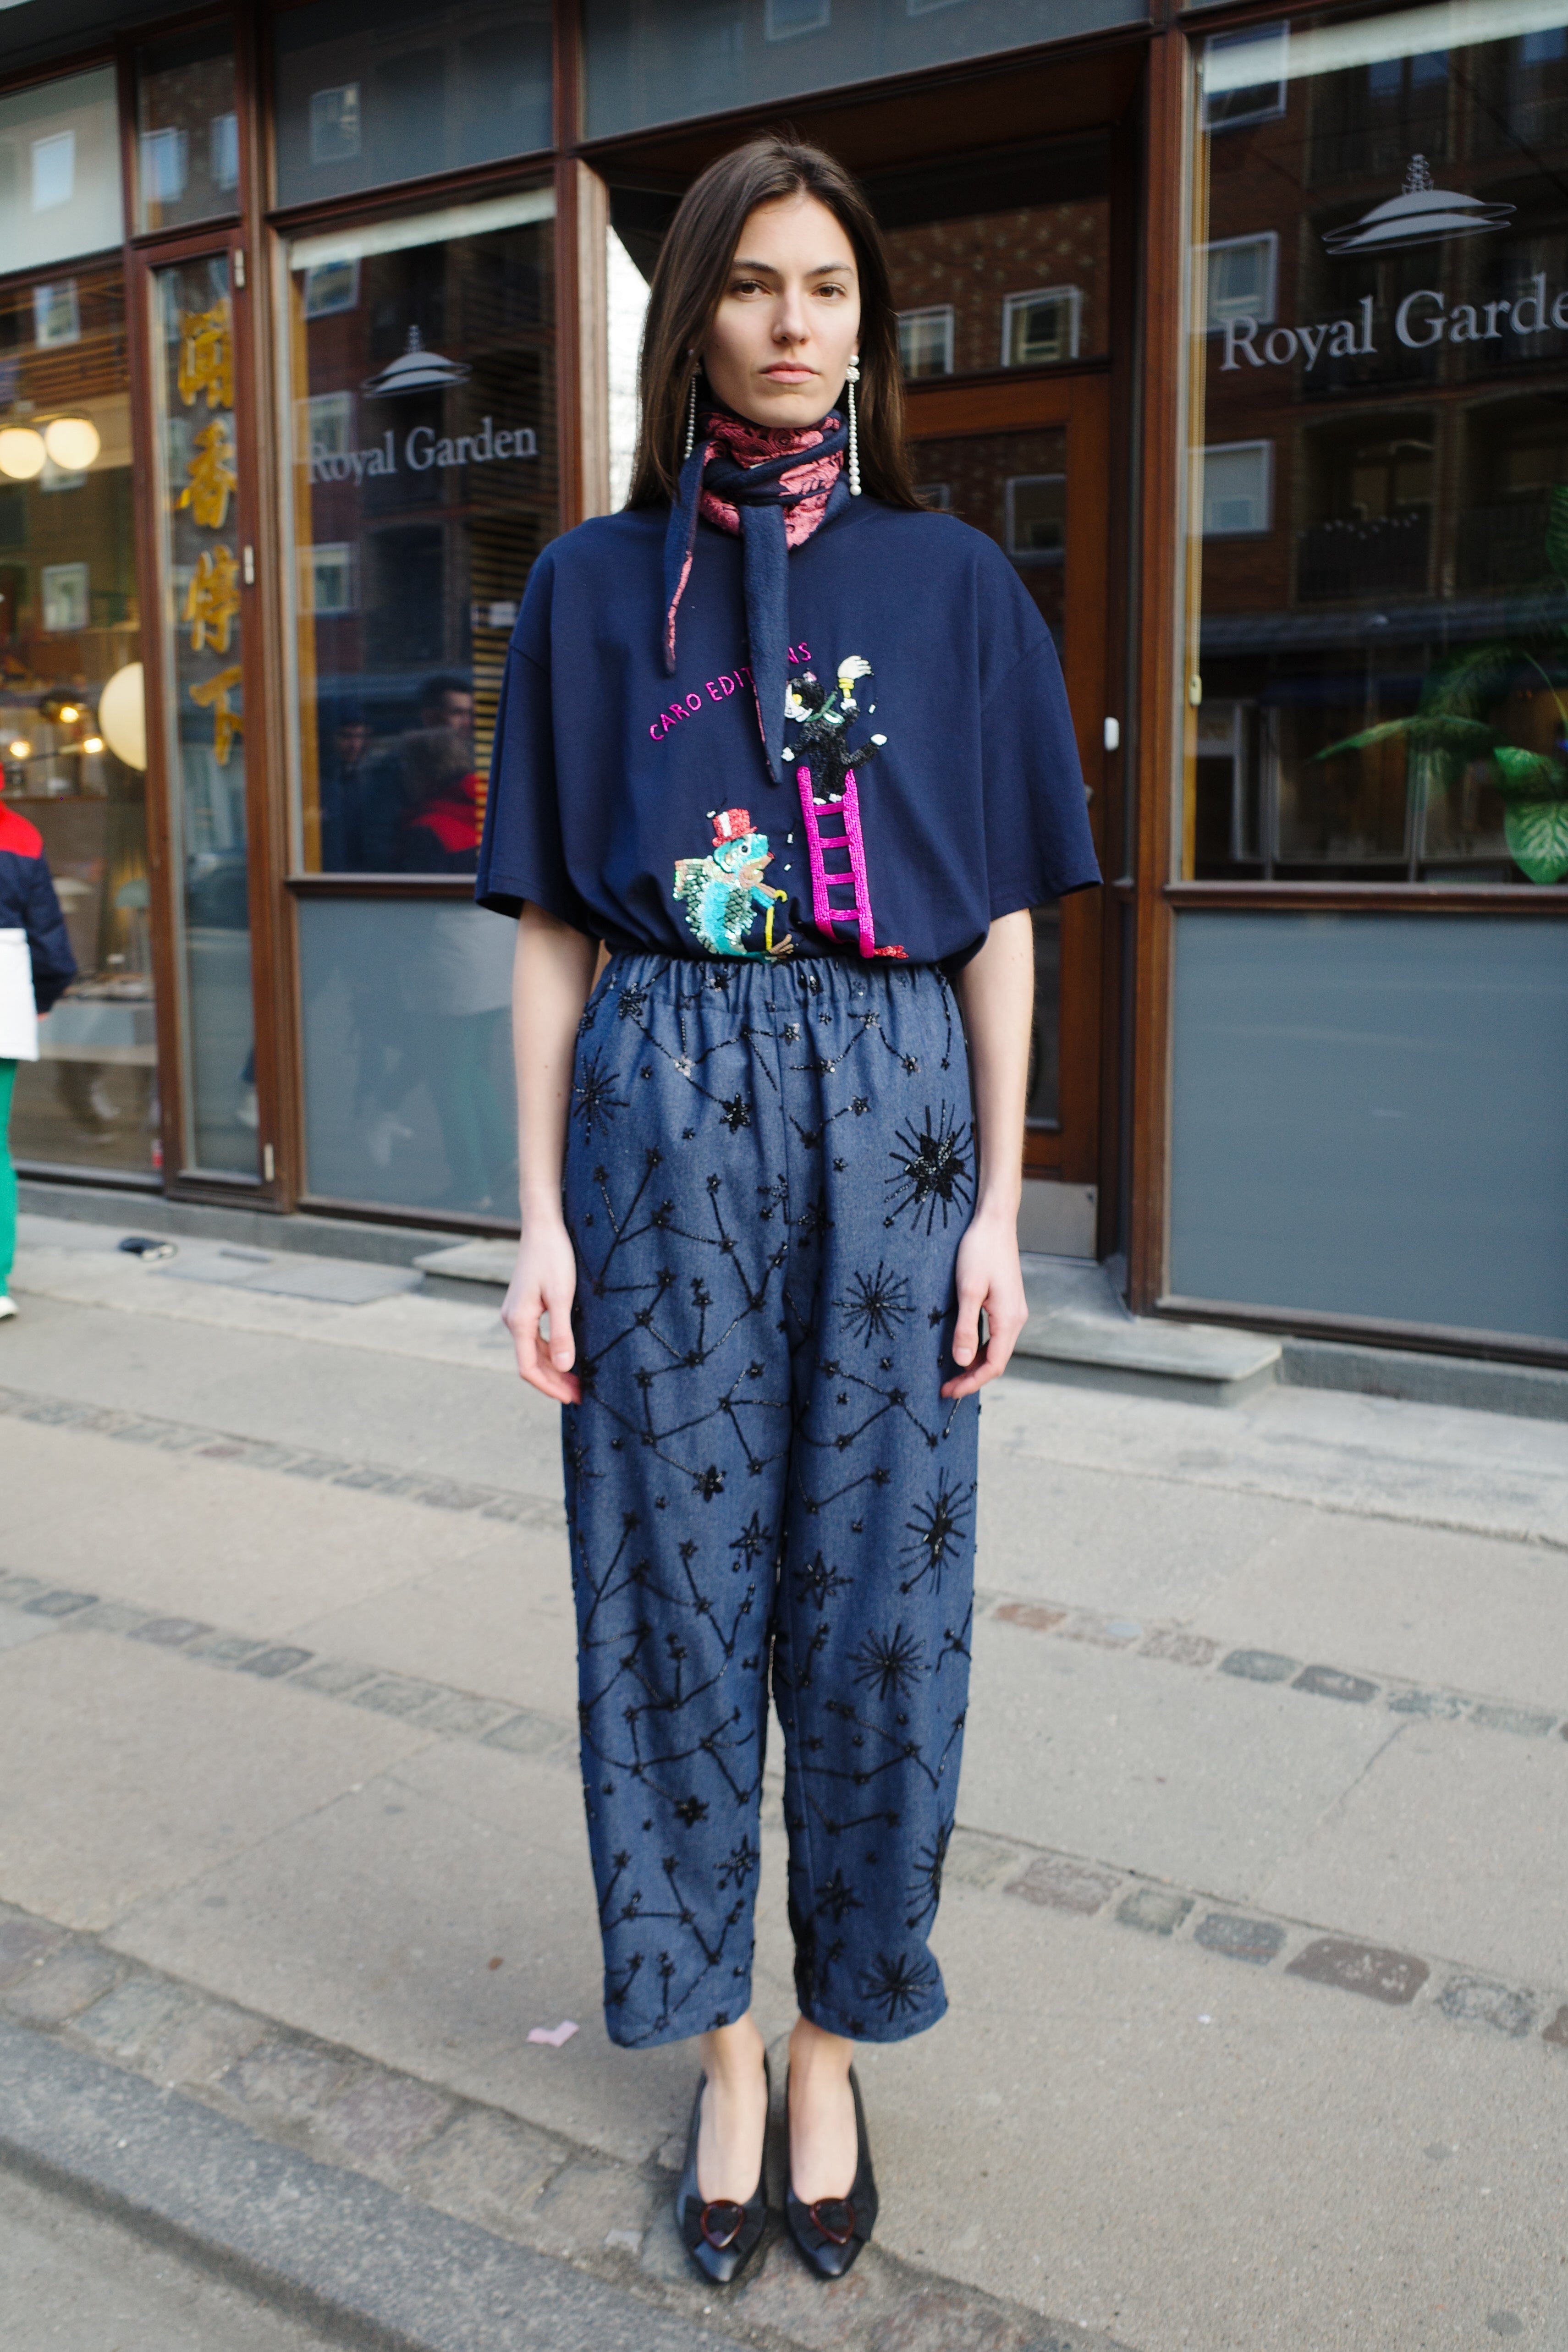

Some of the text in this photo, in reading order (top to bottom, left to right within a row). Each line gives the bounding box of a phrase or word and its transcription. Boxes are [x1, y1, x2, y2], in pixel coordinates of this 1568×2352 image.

[1221, 294, 1377, 371] Royal
[308, 416, 539, 486] Royal Garden
[649, 693, 702, 741] CARO
